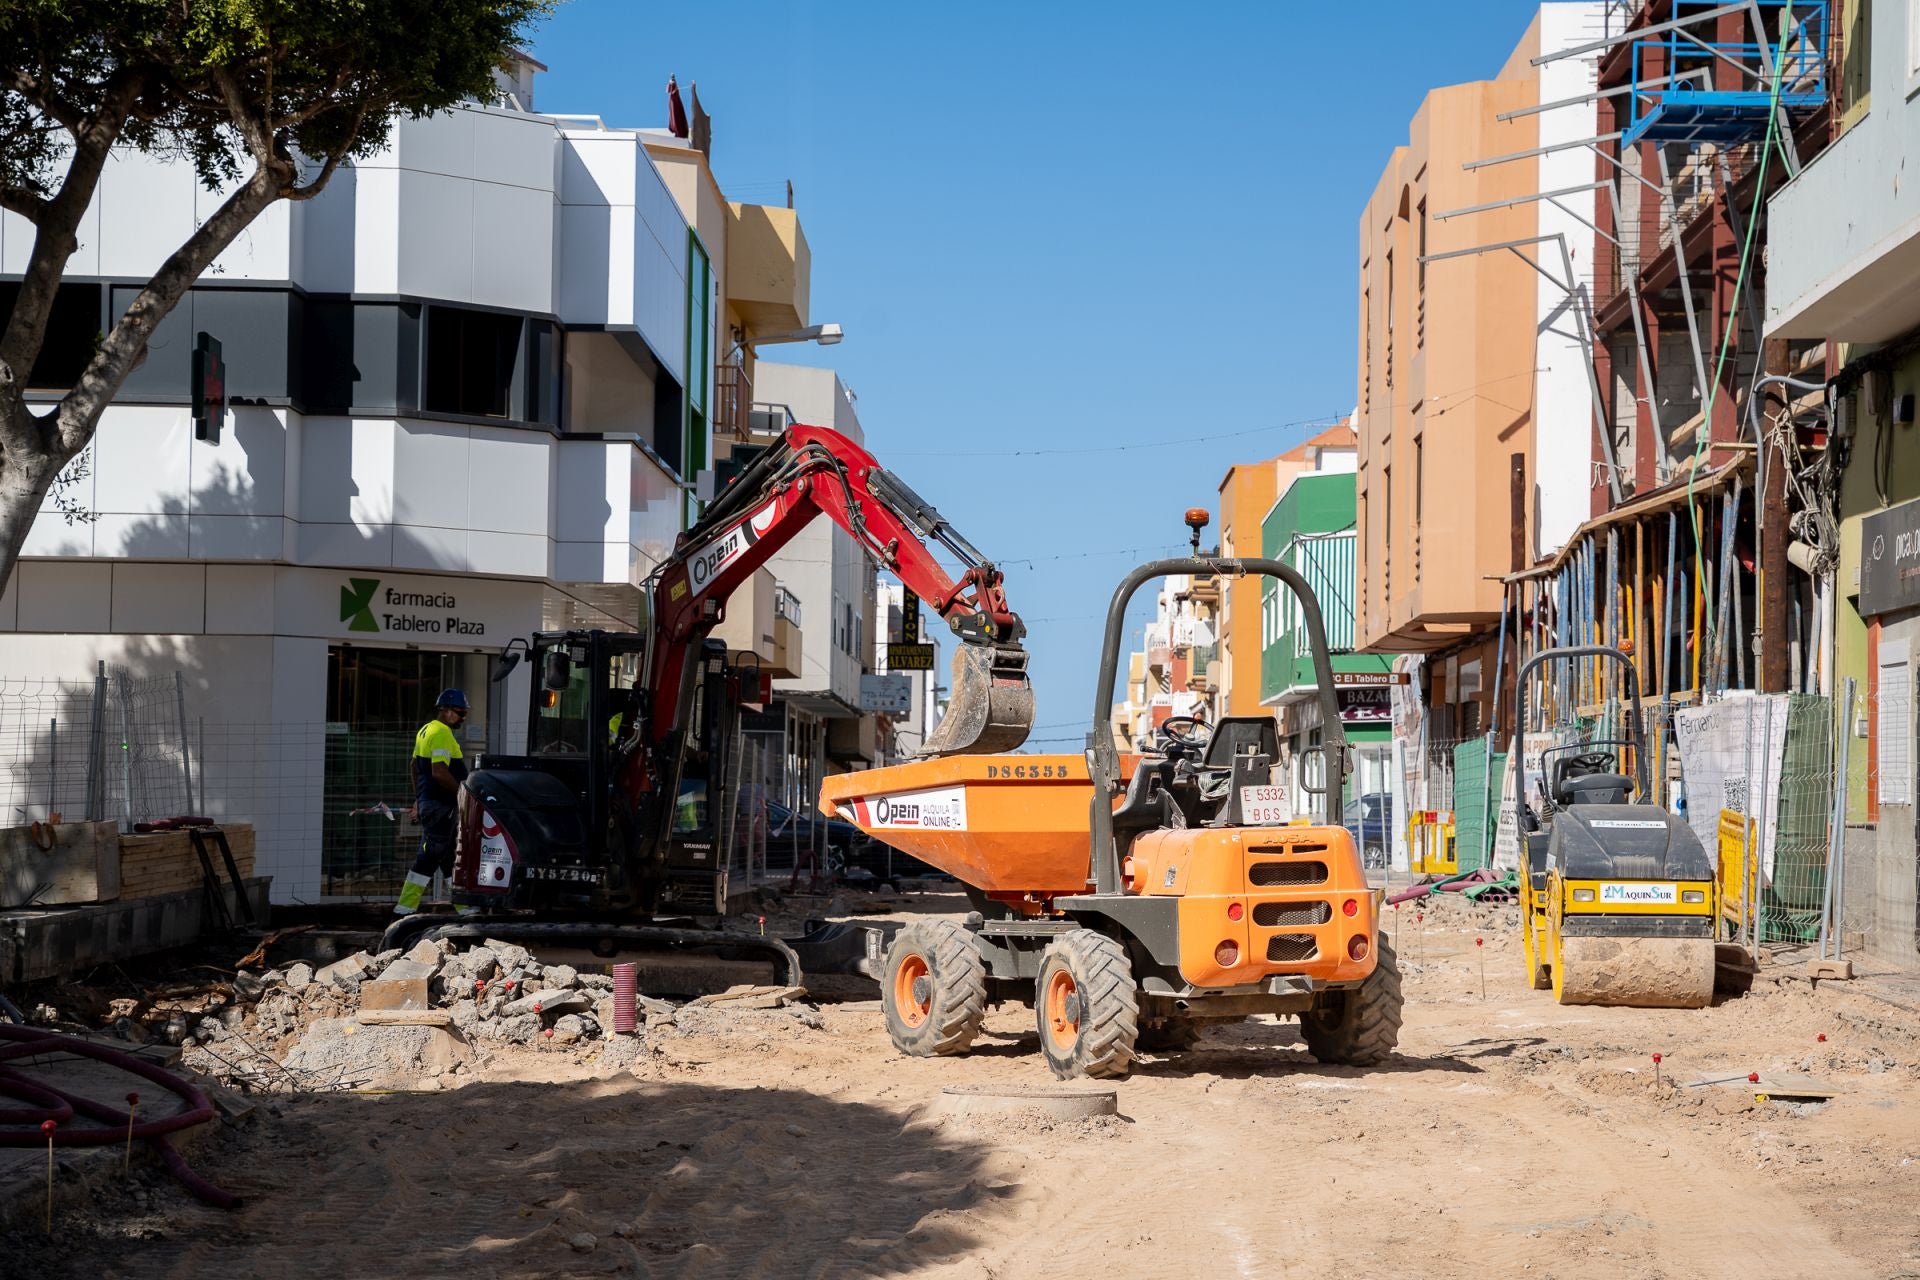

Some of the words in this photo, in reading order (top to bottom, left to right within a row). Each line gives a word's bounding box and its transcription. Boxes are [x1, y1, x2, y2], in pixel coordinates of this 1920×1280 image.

[694, 533, 738, 584] Opein
[386, 588, 456, 608] farmacia
[383, 614, 441, 633] Tablero
[446, 617, 485, 635] Plaza
[889, 656, 933, 669] ALVAREZ
[1344, 674, 1353, 683] El
[1355, 674, 1388, 683] Tablero
[987, 765, 1068, 779] DSG355
[1243, 789, 1251, 802] E
[1256, 787, 1285, 801] 5332
[876, 796, 919, 825] Opein
[923, 803, 950, 816] ALQUILA
[1253, 807, 1280, 821] BGS
[923, 816, 951, 828] ONLINE
[526, 867, 591, 881] EY5720
